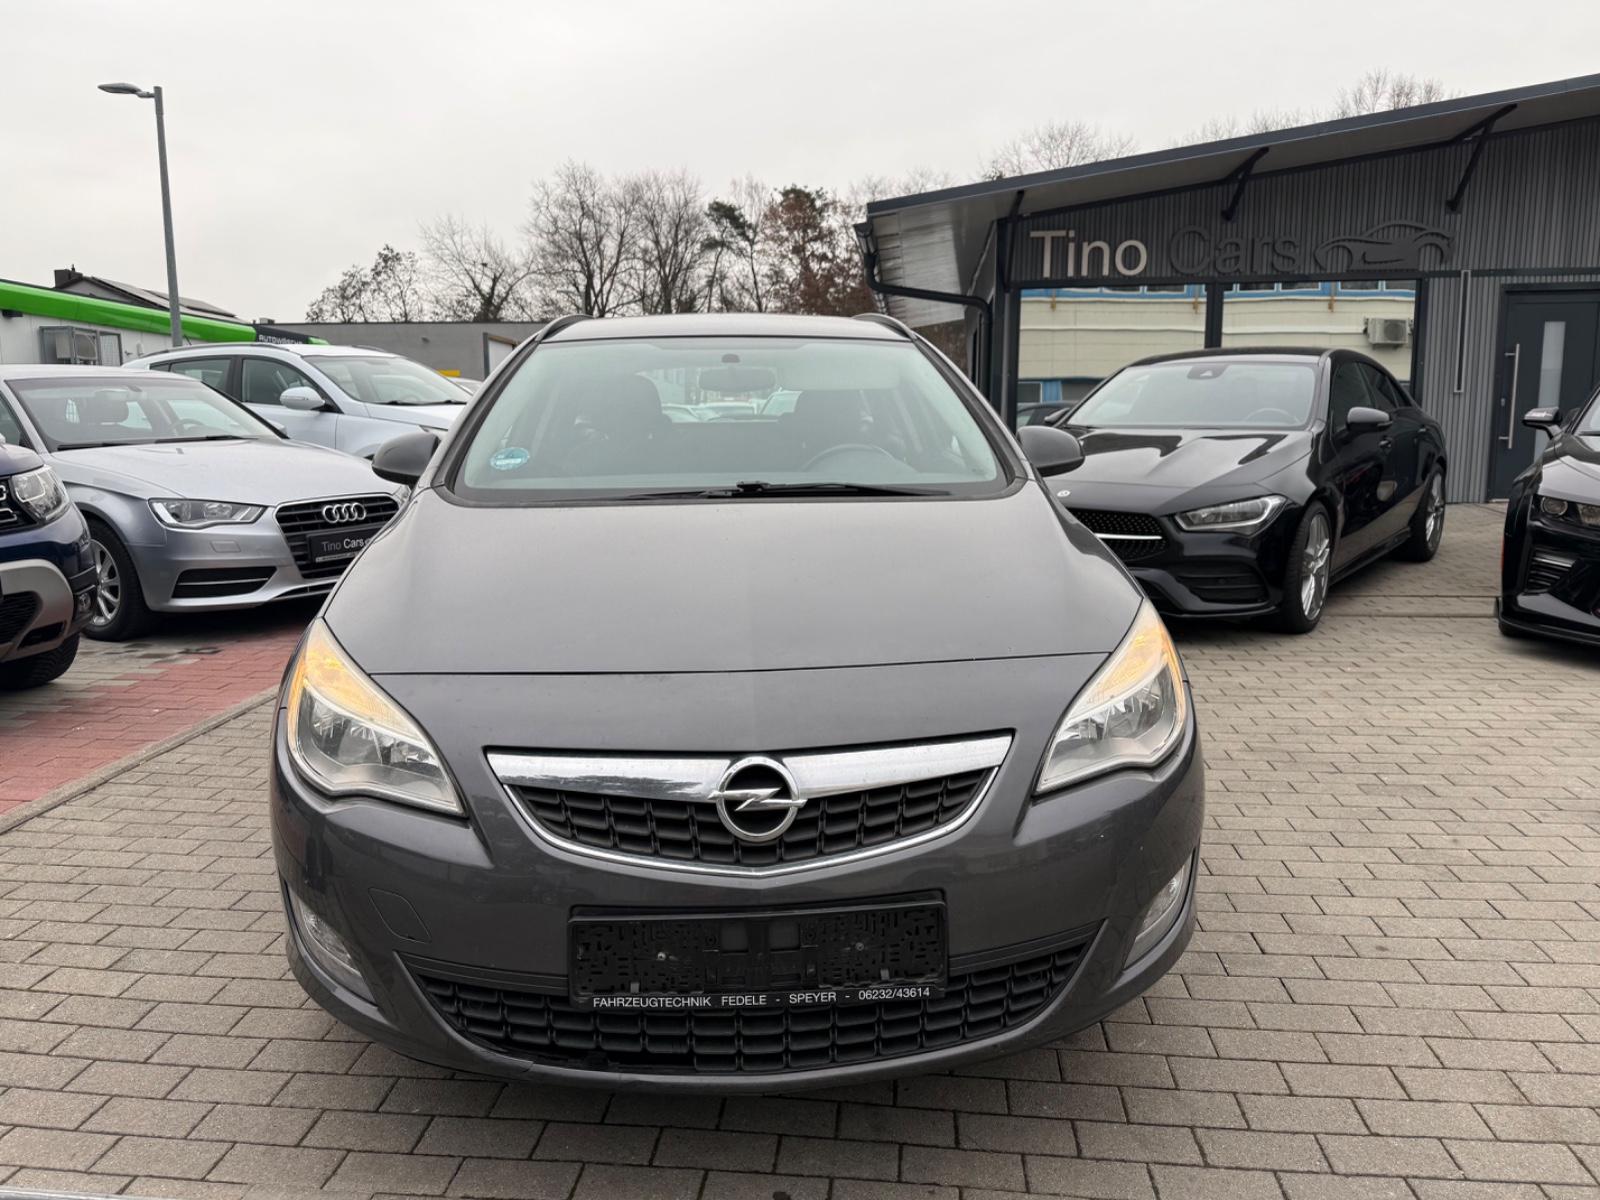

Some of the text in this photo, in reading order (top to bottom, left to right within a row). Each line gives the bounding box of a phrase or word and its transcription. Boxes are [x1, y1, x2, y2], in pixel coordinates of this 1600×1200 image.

[1030, 225, 1301, 278] Tino Cars
[321, 538, 364, 552] Tino Cars
[593, 996, 711, 1008] FAHRZEUGTECHNIK
[721, 995, 767, 1006] FEDELE
[789, 992, 837, 1004] SPEYER
[858, 987, 930, 1000] 06232/43614
